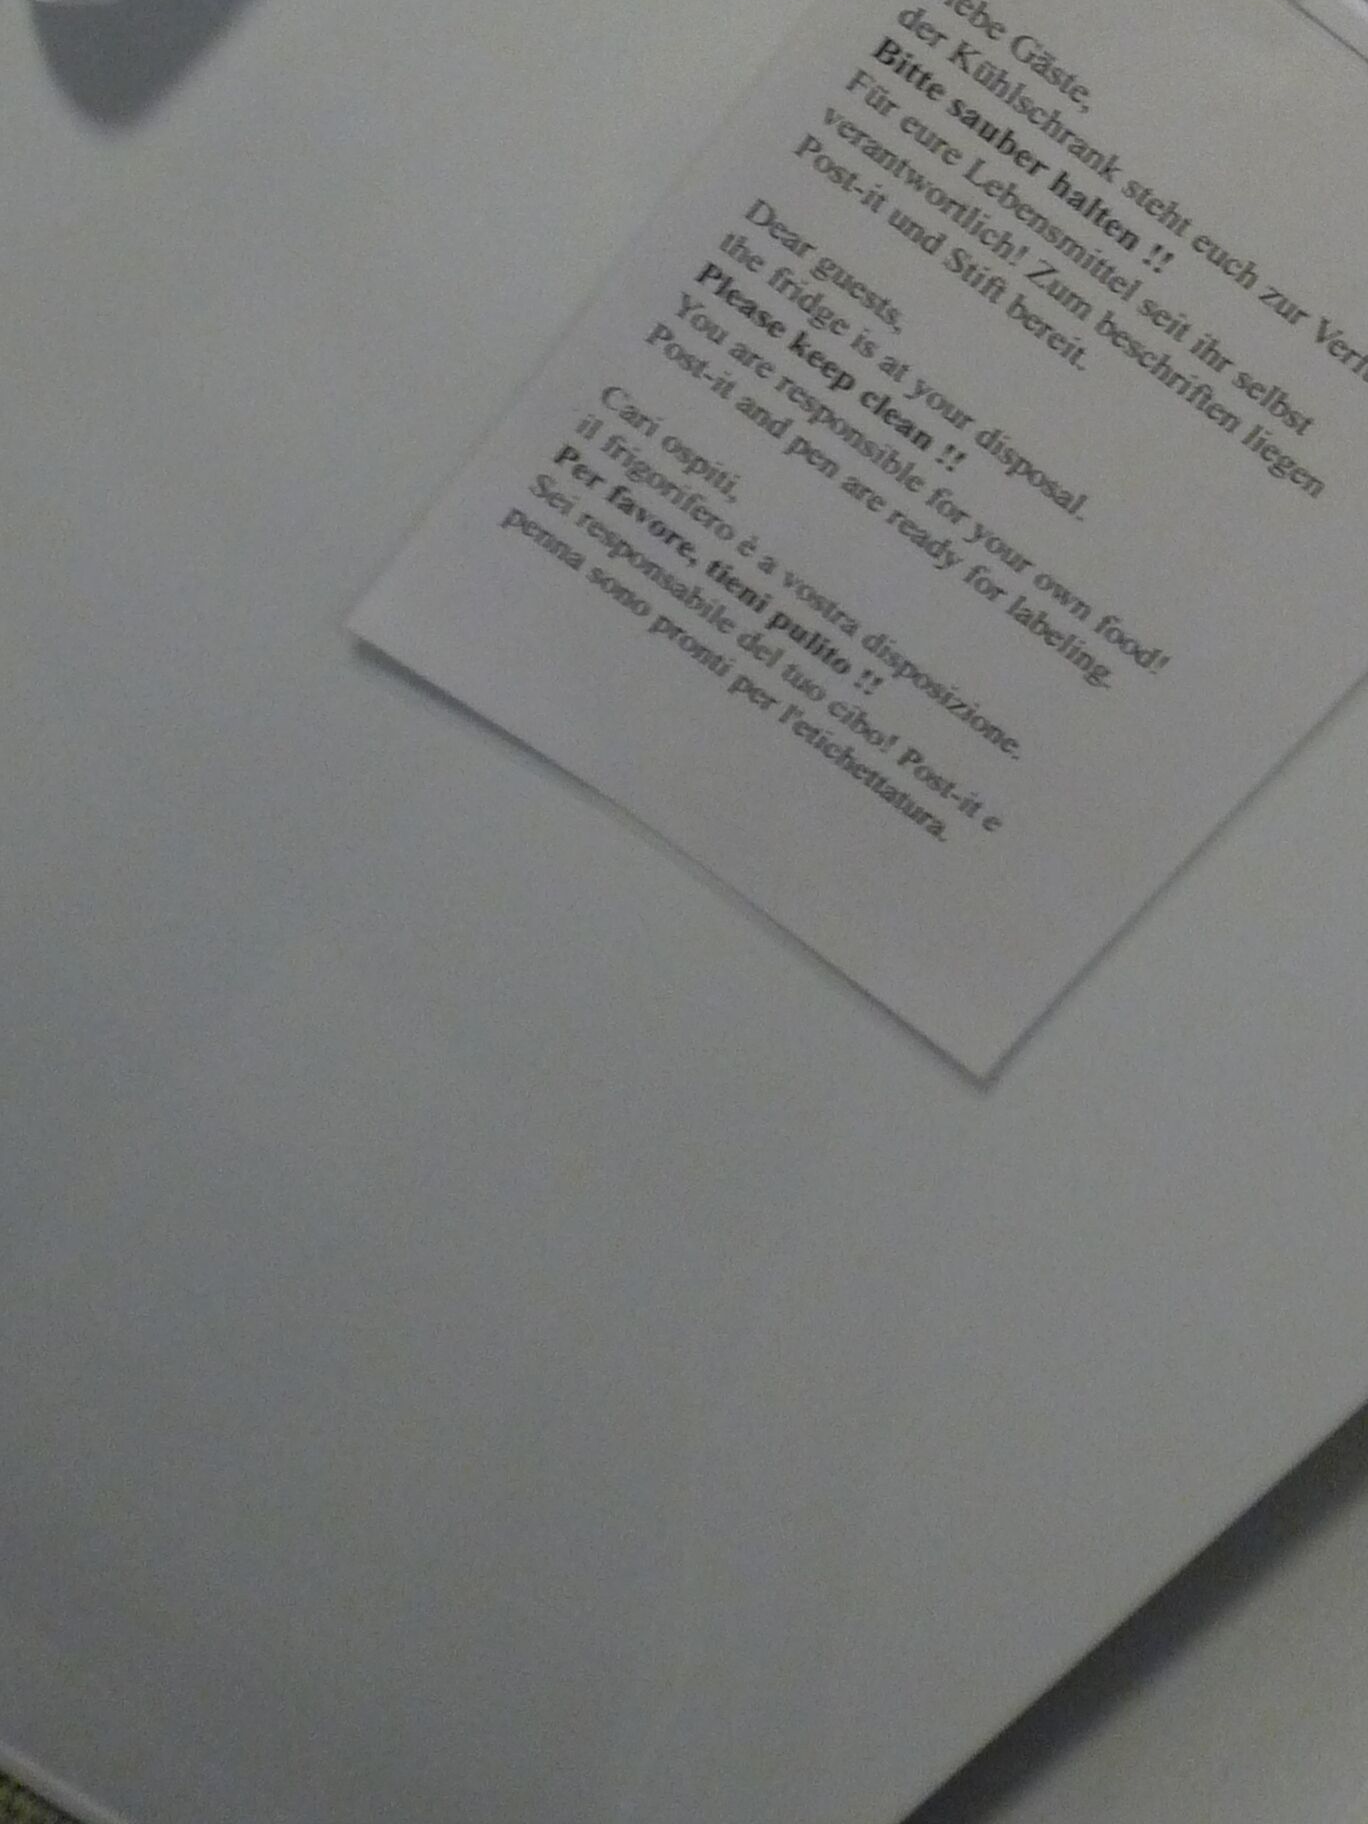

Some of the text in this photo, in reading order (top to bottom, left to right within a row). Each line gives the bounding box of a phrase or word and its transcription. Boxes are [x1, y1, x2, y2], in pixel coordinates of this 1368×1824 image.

[870, 35, 945, 101] Bitte
[946, 98, 1049, 175] sauber
[1047, 170, 1140, 251] halten
[896, 6, 949, 48] der
[1121, 180, 1192, 237] steht
[1190, 234, 1258, 289] euch
[1256, 284, 1311, 326] zur
[1009, 34, 1090, 113] Gäste,
[743, 198, 901, 334] Dear guests,
[793, 133, 887, 213] Post-it
[887, 208, 947, 255] und
[942, 247, 1006, 303] Stift
[845, 68, 899, 116] Für
[899, 116, 962, 165] eure
[1137, 298, 1191, 341] seit
[1188, 332, 1235, 373] ihr
[1231, 371, 1314, 436] selbst
[600, 386, 739, 502] Cari ospiti,
[645, 322, 736, 399] Post-it
[735, 396, 793, 438] and
[782, 435, 839, 478] pen
[838, 475, 887, 513] are
[885, 509, 963, 570] ready
[962, 563, 1008, 602] for
[693, 261, 786, 337] Please
[787, 330, 856, 391] keep
[858, 390, 933, 451] clean
[718, 231, 1088, 521] the fridge is at your disposal.
[1024, 260, 1092, 320] Zum
[1241, 424, 1324, 498] liegen
[552, 443, 605, 488] Per
[605, 485, 697, 566] favore,
[705, 560, 772, 613] tieni
[764, 610, 851, 674] pulito
[574, 413, 604, 441] il
[735, 534, 758, 557] è
[756, 554, 779, 575] a
[783, 571, 859, 637] vostra
[675, 291, 728, 344] You
[727, 341, 775, 379] are
[924, 487, 971, 525] for
[962, 522, 1035, 573] your
[1033, 573, 1091, 621] own
[1093, 615, 1170, 674] food!
[499, 507, 585, 570] penna
[586, 567, 651, 616] sono
[647, 614, 734, 677] pronti
[726, 673, 780, 711] per
[528, 473, 574, 515] Sei
[736, 631, 784, 668] del
[780, 663, 826, 701] tuo
[828, 702, 899, 752] cibo!
[896, 746, 983, 818] Post-it
[980, 814, 1003, 832] e
